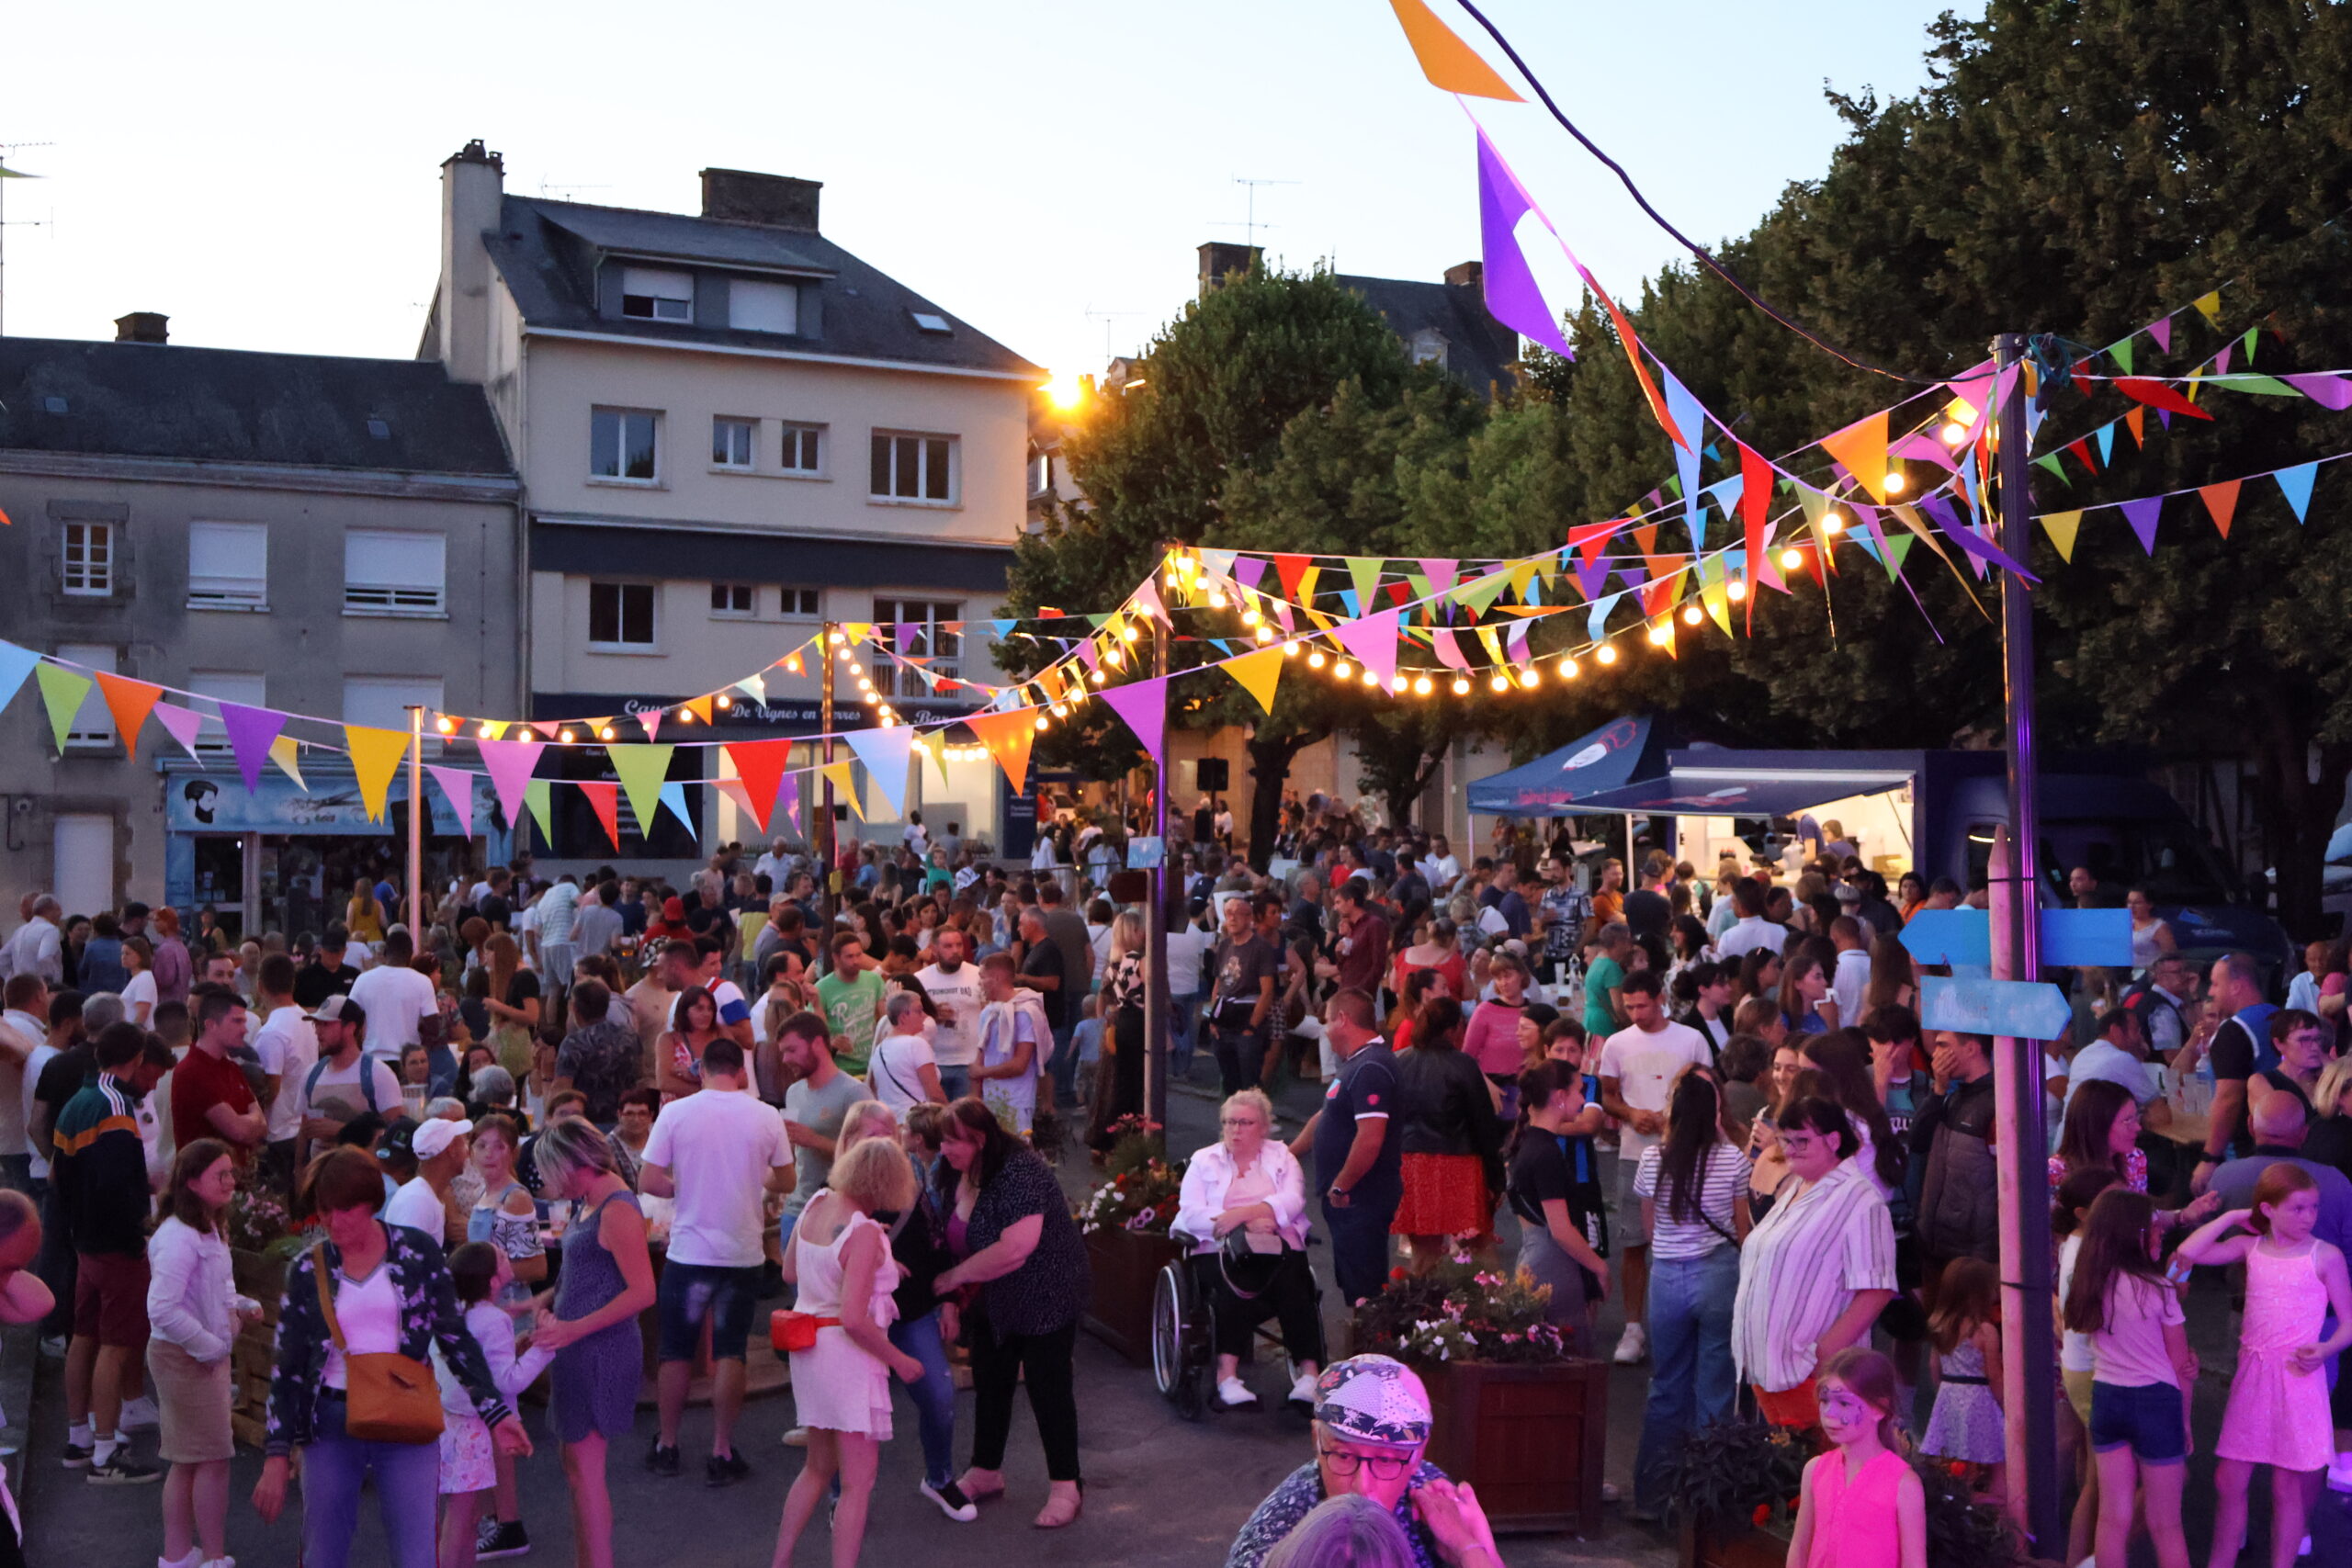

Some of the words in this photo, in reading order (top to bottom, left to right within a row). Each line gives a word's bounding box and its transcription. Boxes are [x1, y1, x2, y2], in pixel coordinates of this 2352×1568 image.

[731, 703, 751, 718] De
[755, 705, 798, 723] Vignes
[802, 709, 817, 719] en
[820, 705, 861, 720] rres
